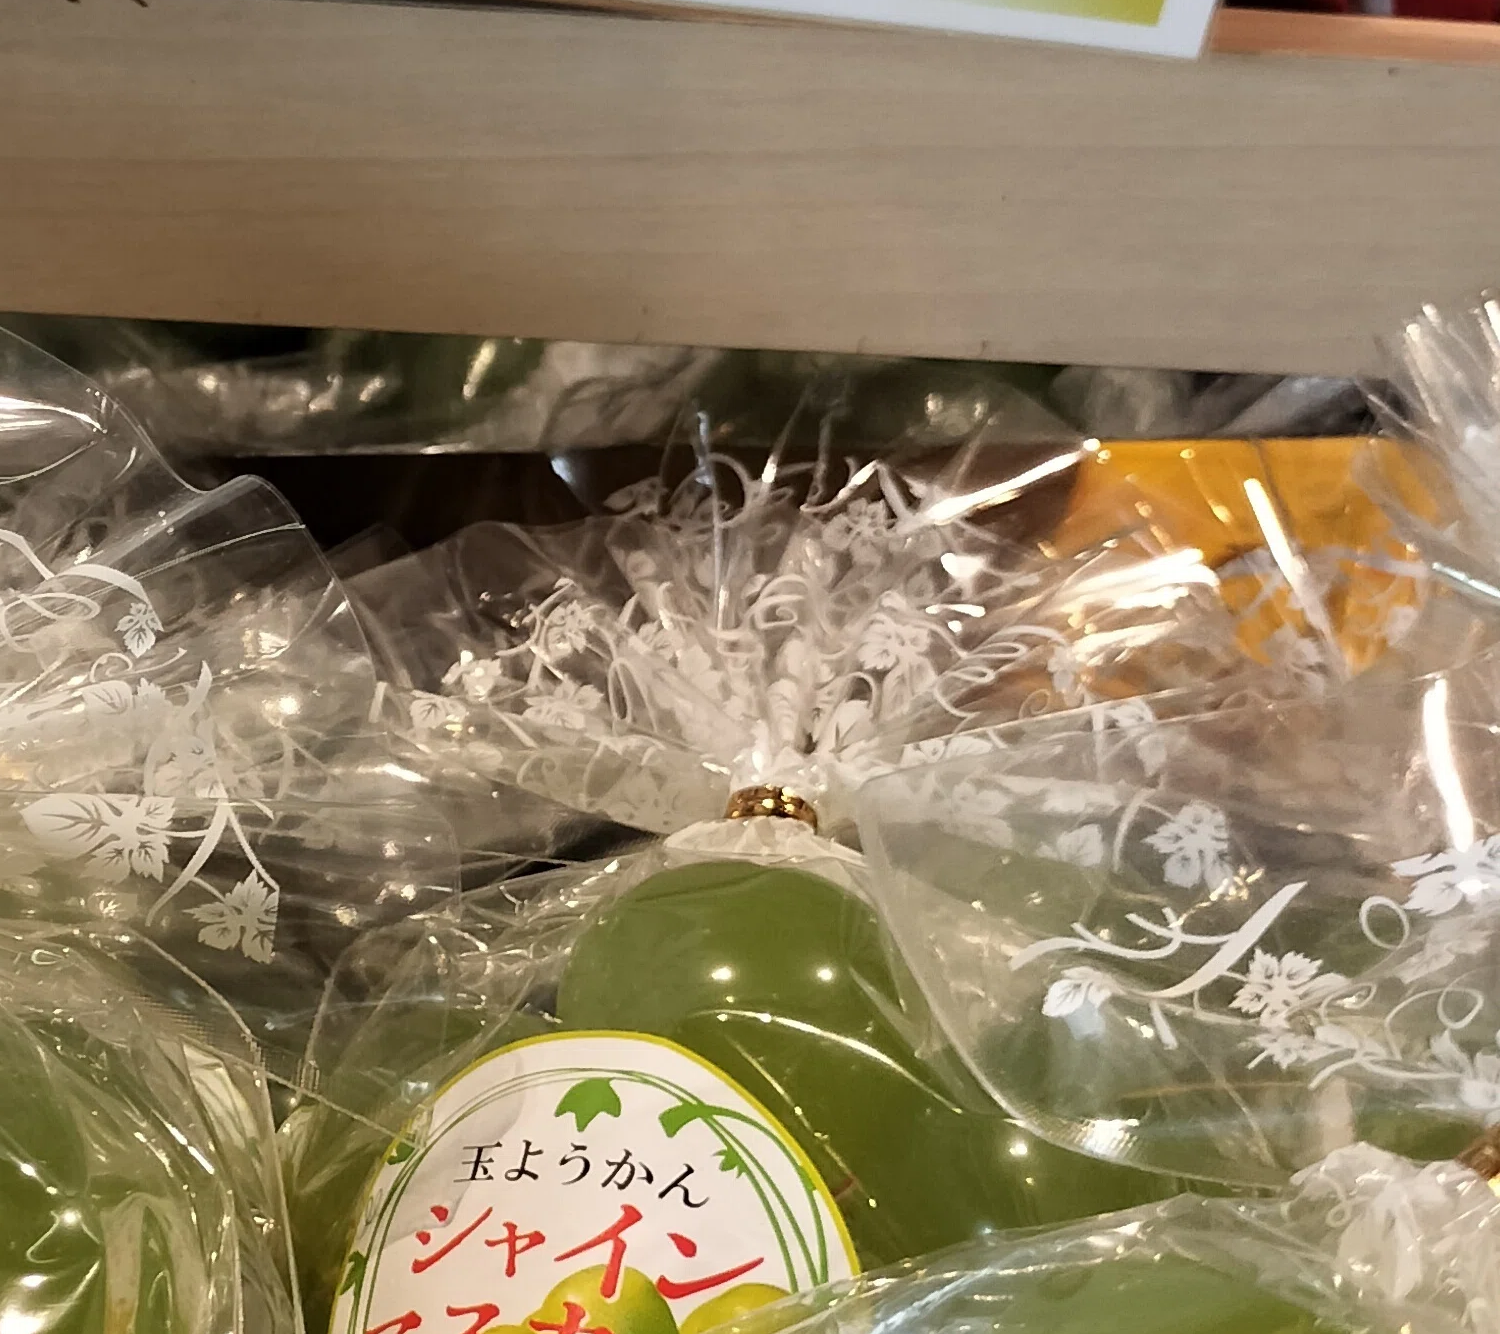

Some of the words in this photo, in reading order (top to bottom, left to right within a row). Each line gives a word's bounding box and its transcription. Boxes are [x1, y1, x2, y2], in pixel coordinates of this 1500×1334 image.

[452, 1139, 710, 1208] 玉ようかん
[410, 1203, 765, 1299] シャイン
